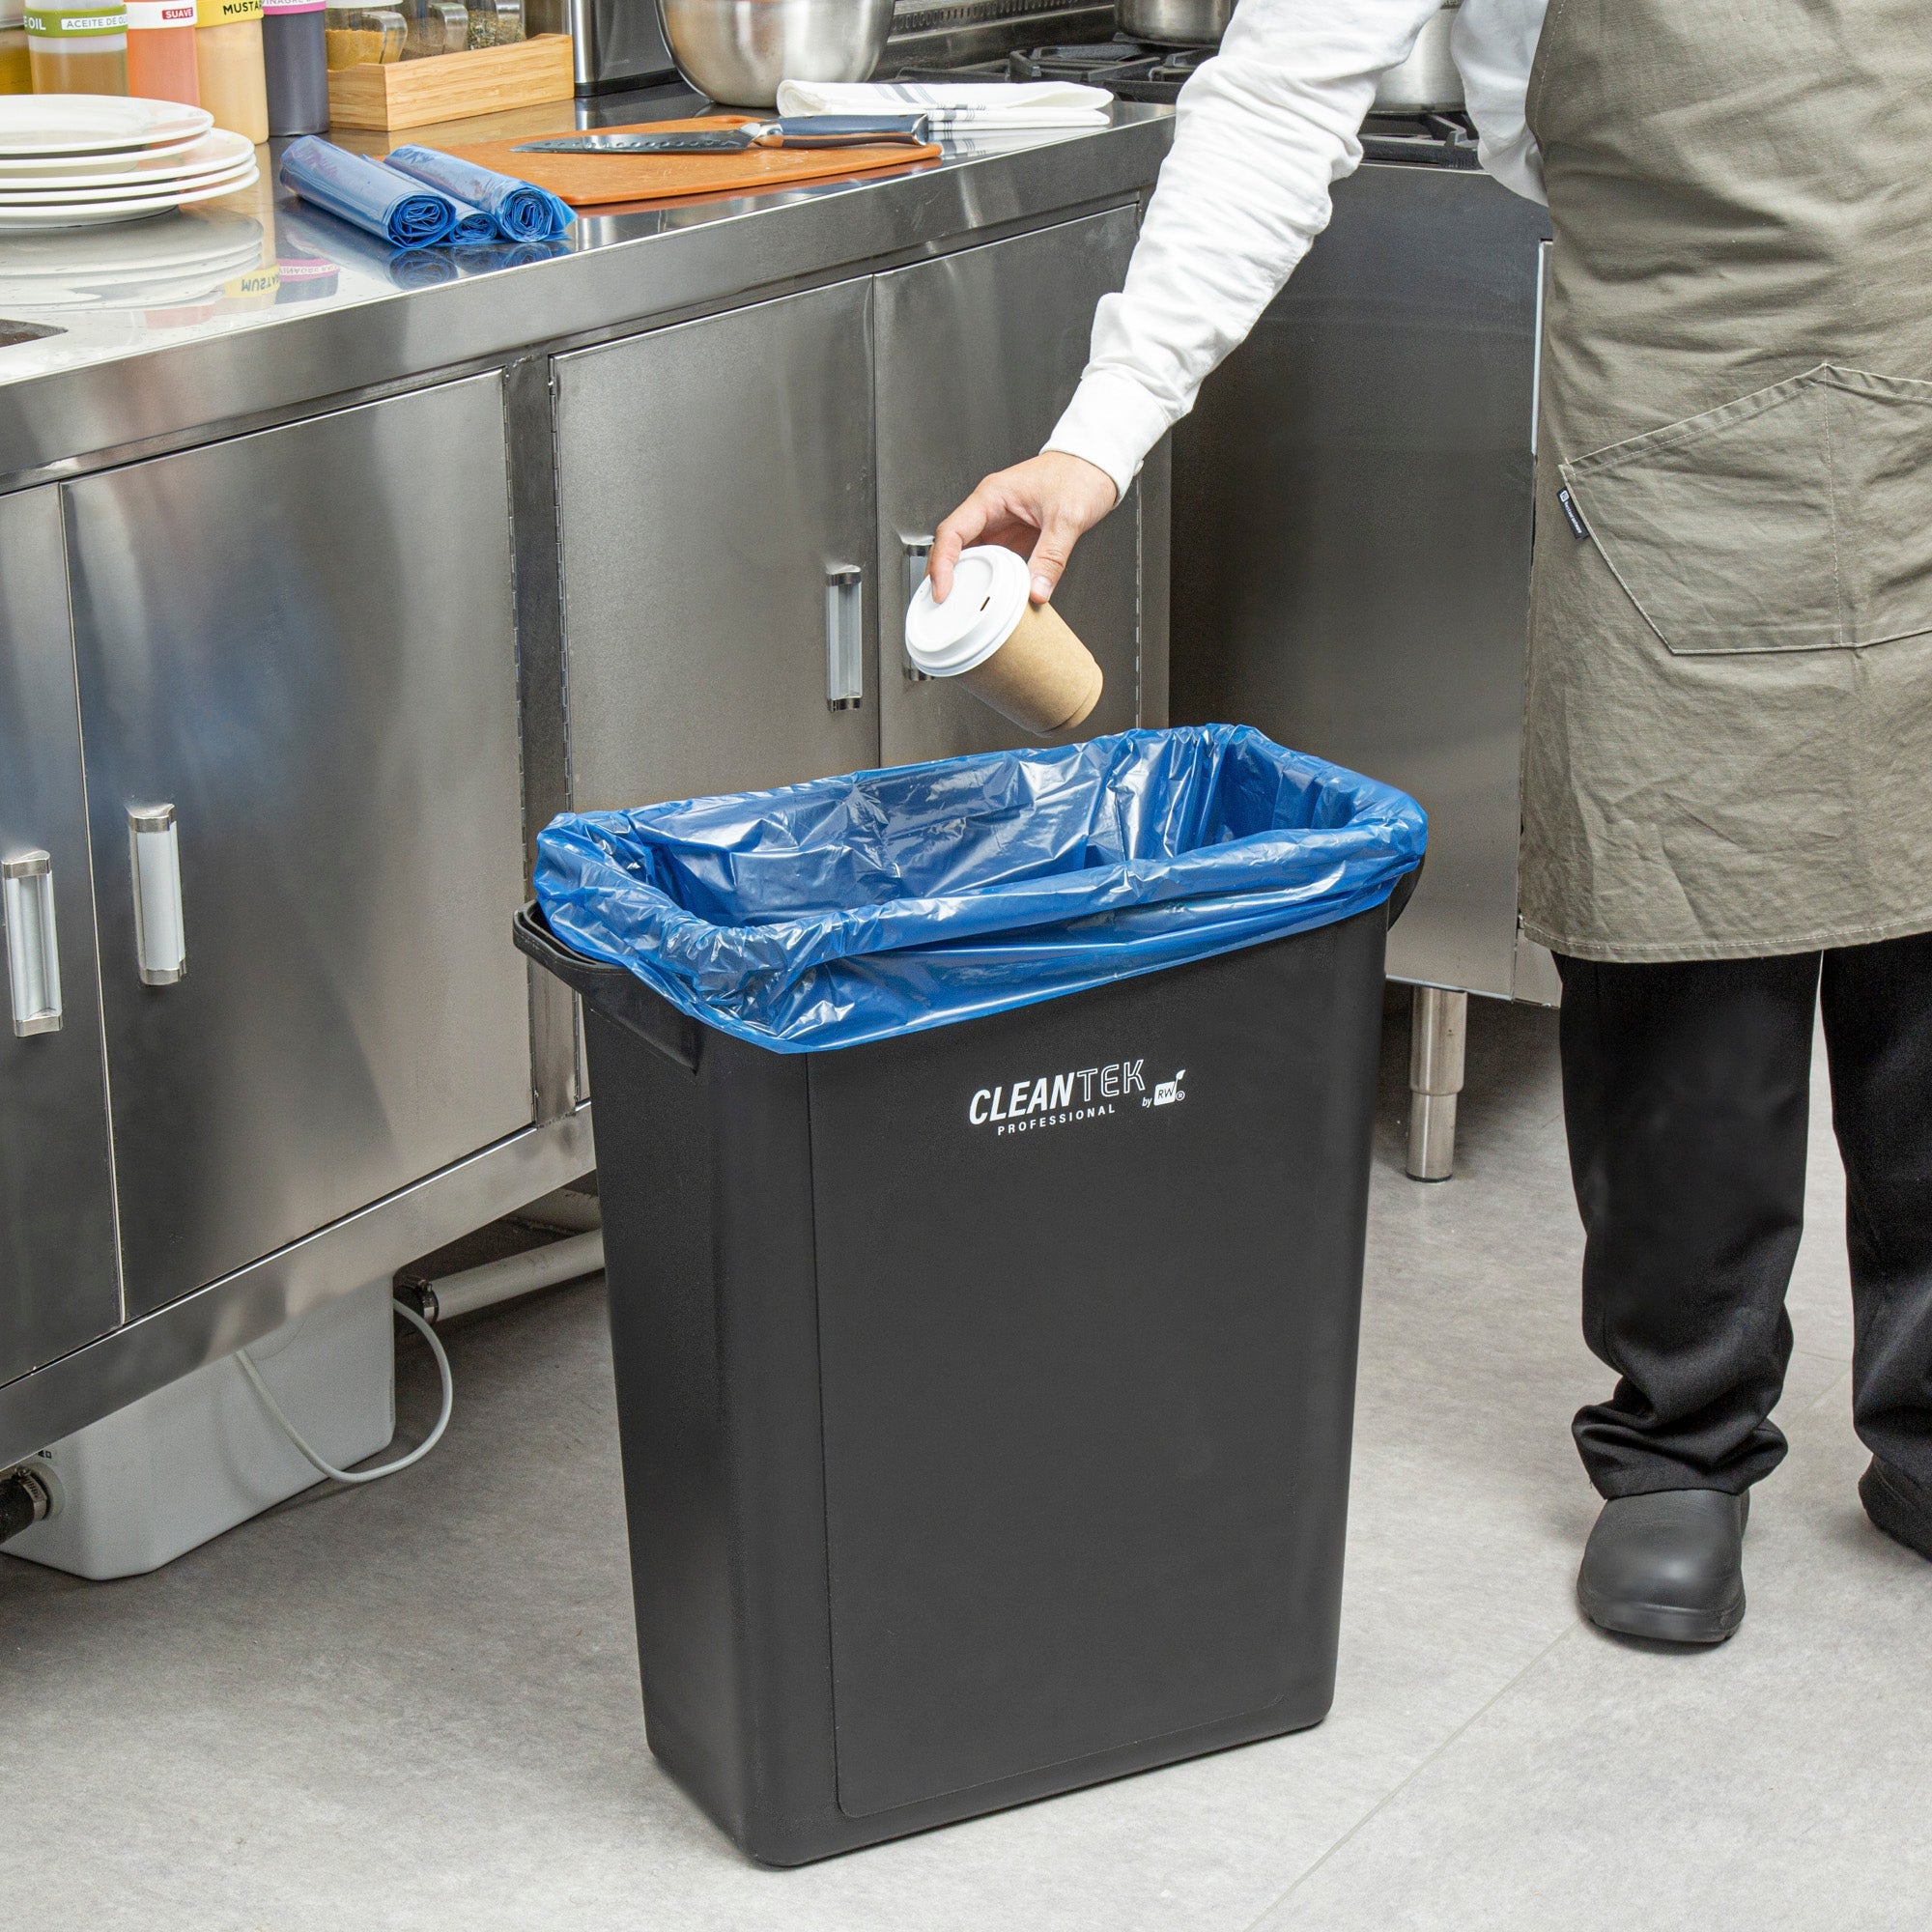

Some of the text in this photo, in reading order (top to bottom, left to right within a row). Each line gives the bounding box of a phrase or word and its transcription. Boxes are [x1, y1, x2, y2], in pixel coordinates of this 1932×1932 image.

[165, 8, 192, 19] SUAVE
[28, 16, 46, 30] OIL
[66, 17, 103, 29] ACEITE
[106, 16, 117, 26] DE
[969, 1059, 1146, 1125] CLEANTEK
[1142, 1096, 1152, 1109] by
[997, 1103, 1116, 1136] PROFESSIONAL
